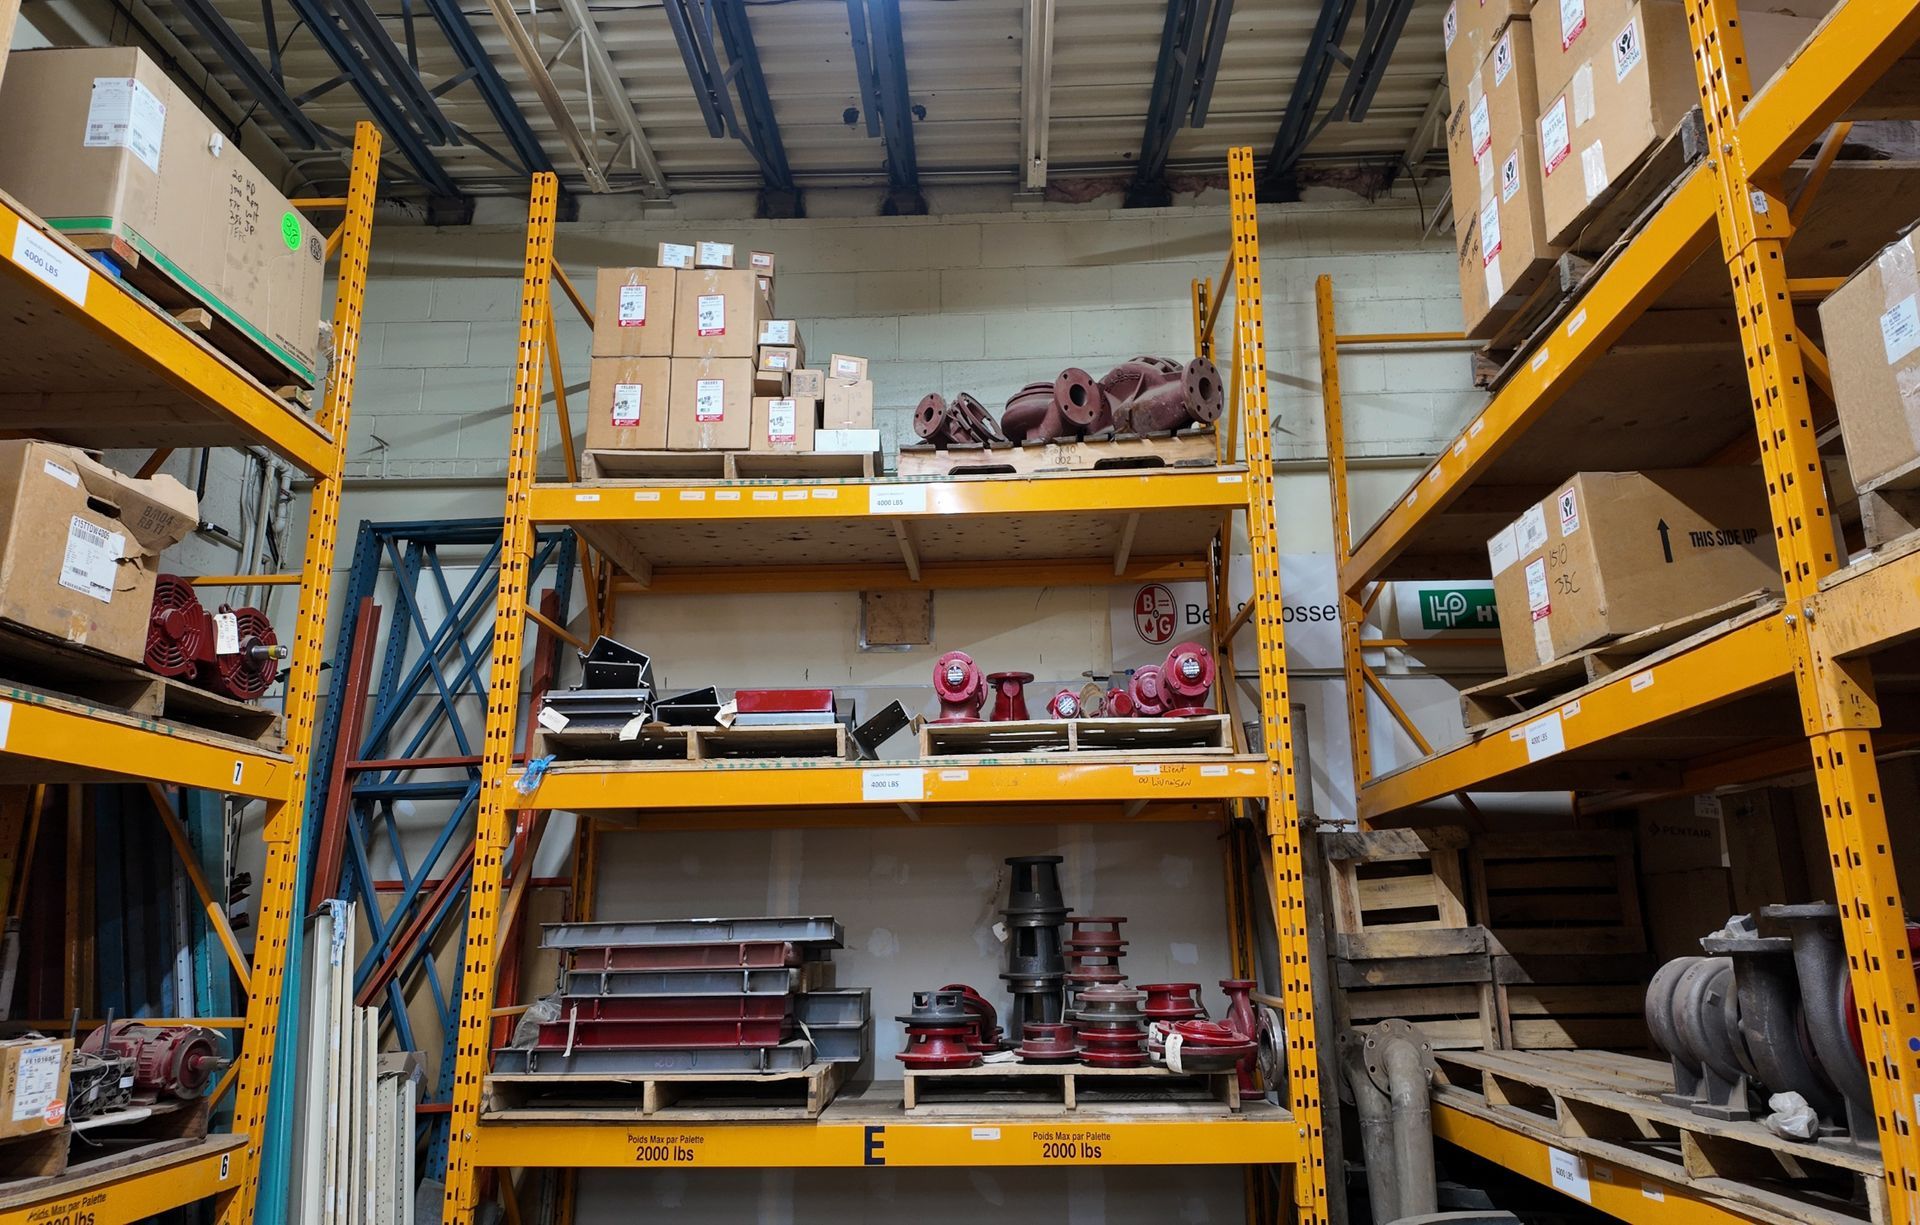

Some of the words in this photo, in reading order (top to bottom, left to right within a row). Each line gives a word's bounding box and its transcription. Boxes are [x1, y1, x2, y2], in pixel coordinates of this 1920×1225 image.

[232, 169, 242, 182] 20
[24, 249, 44, 267] 4000
[45, 261, 59, 277] LBS
[877, 499, 892, 507] 4000
[1688, 531, 1715, 548] THIS
[1716, 529, 1741, 546] SIDE
[1743, 528, 1758, 545] UP
[1143, 594, 1154, 612] B
[1158, 616, 1171, 634] G
[1186, 604, 1211, 625] Be
[235, 762, 242, 781] 7
[888, 780, 899, 788] LBS
[1662, 825, 1712, 839] PENTAIR
[628, 1135, 648, 1144] Poids
[650, 1136, 665, 1144] Max
[667, 1137, 678, 1145] par
[680, 1135, 704, 1144] Palette
[1033, 1132, 1053, 1141] Poids
[1055, 1132, 1071, 1141] Max
[1072, 1133, 1084, 1142] par
[1086, 1131, 1111, 1141] Palette
[636, 1146, 669, 1161] 2000
[674, 1146, 694, 1161] lbs
[864, 1126, 886, 1165] E
[1043, 1143, 1076, 1158] 2000
[1081, 1143, 1102, 1158] lbs
[222, 1155, 228, 1177] 6
[51, 1204, 66, 1217] Max
[68, 1201, 80, 1213] par
[81, 1193, 107, 1207] Palette
